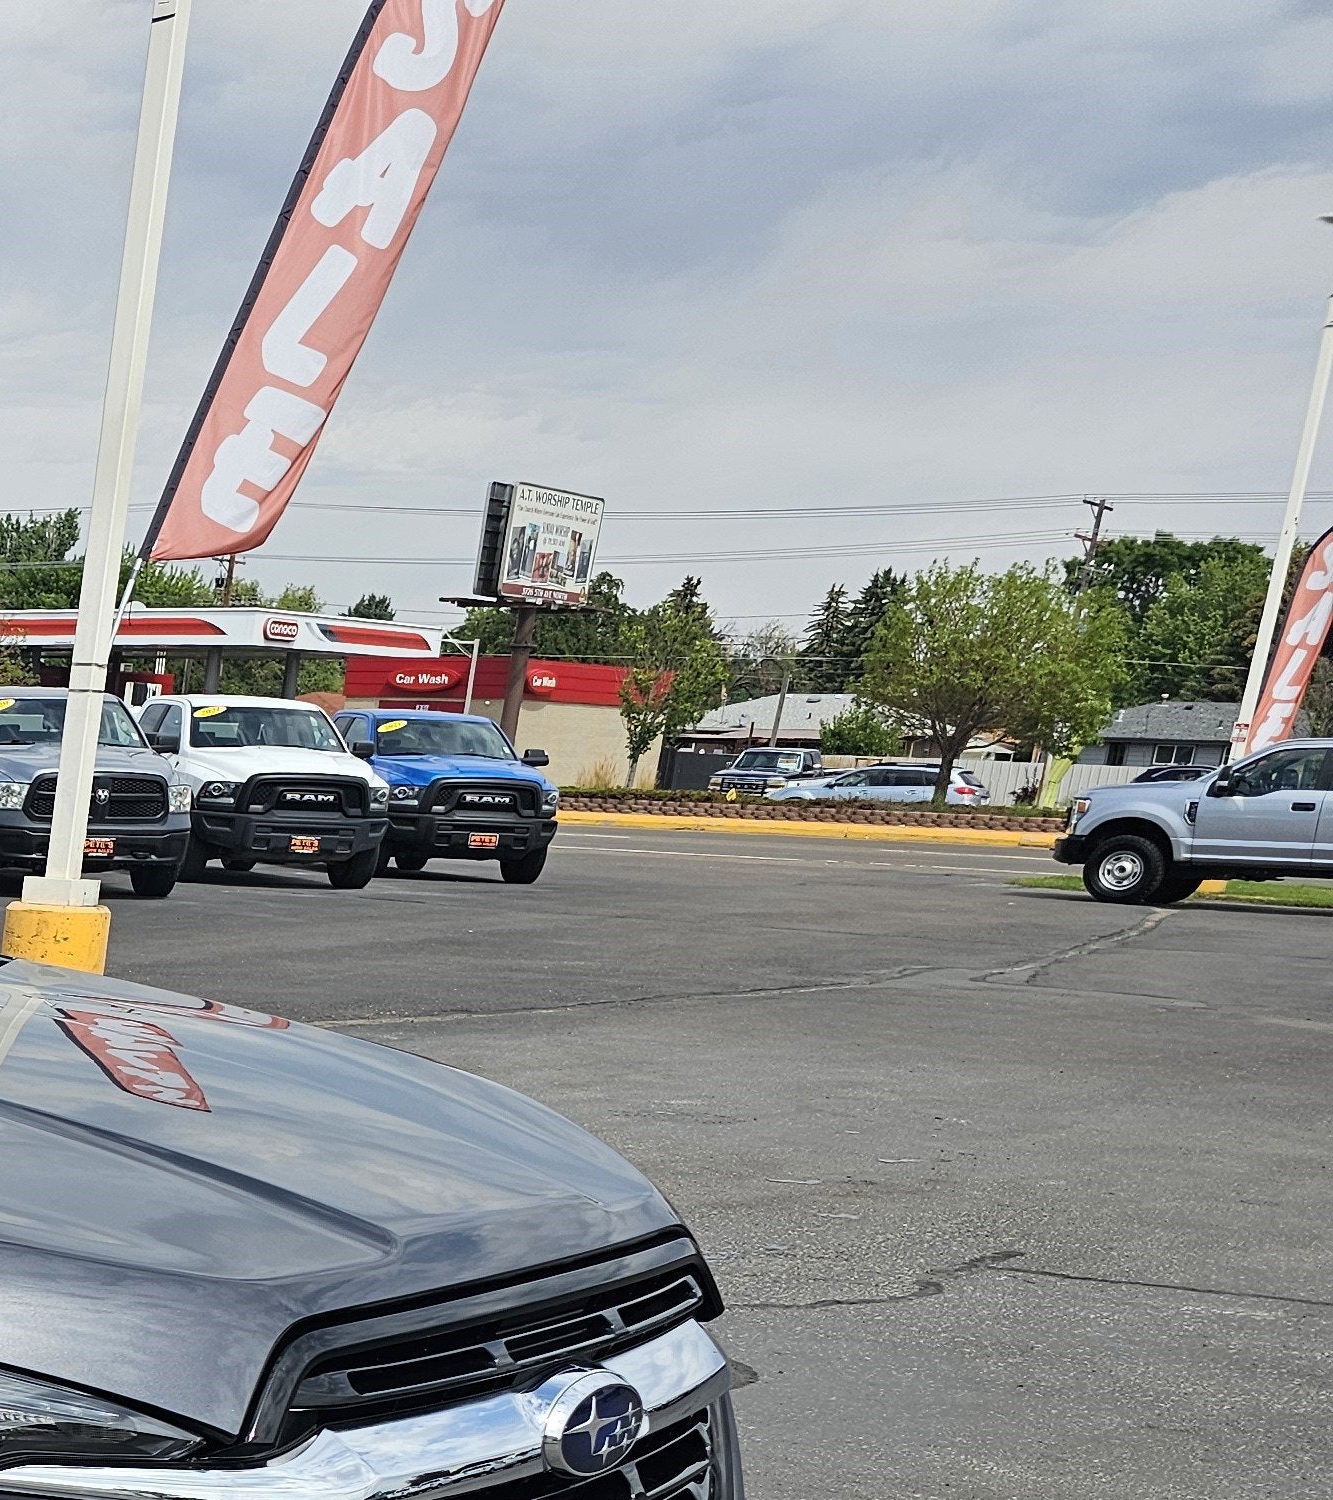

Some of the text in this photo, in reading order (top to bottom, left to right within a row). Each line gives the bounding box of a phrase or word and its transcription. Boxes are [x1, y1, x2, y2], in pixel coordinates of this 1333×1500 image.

[519, 488, 533, 502] A.T.
[535, 490, 570, 508] WORSHIP
[572, 498, 600, 515] TEMPLE
[395, 673, 449, 685] Car Wash
[285, 793, 335, 802] RAM
[464, 795, 511, 804] RAM
